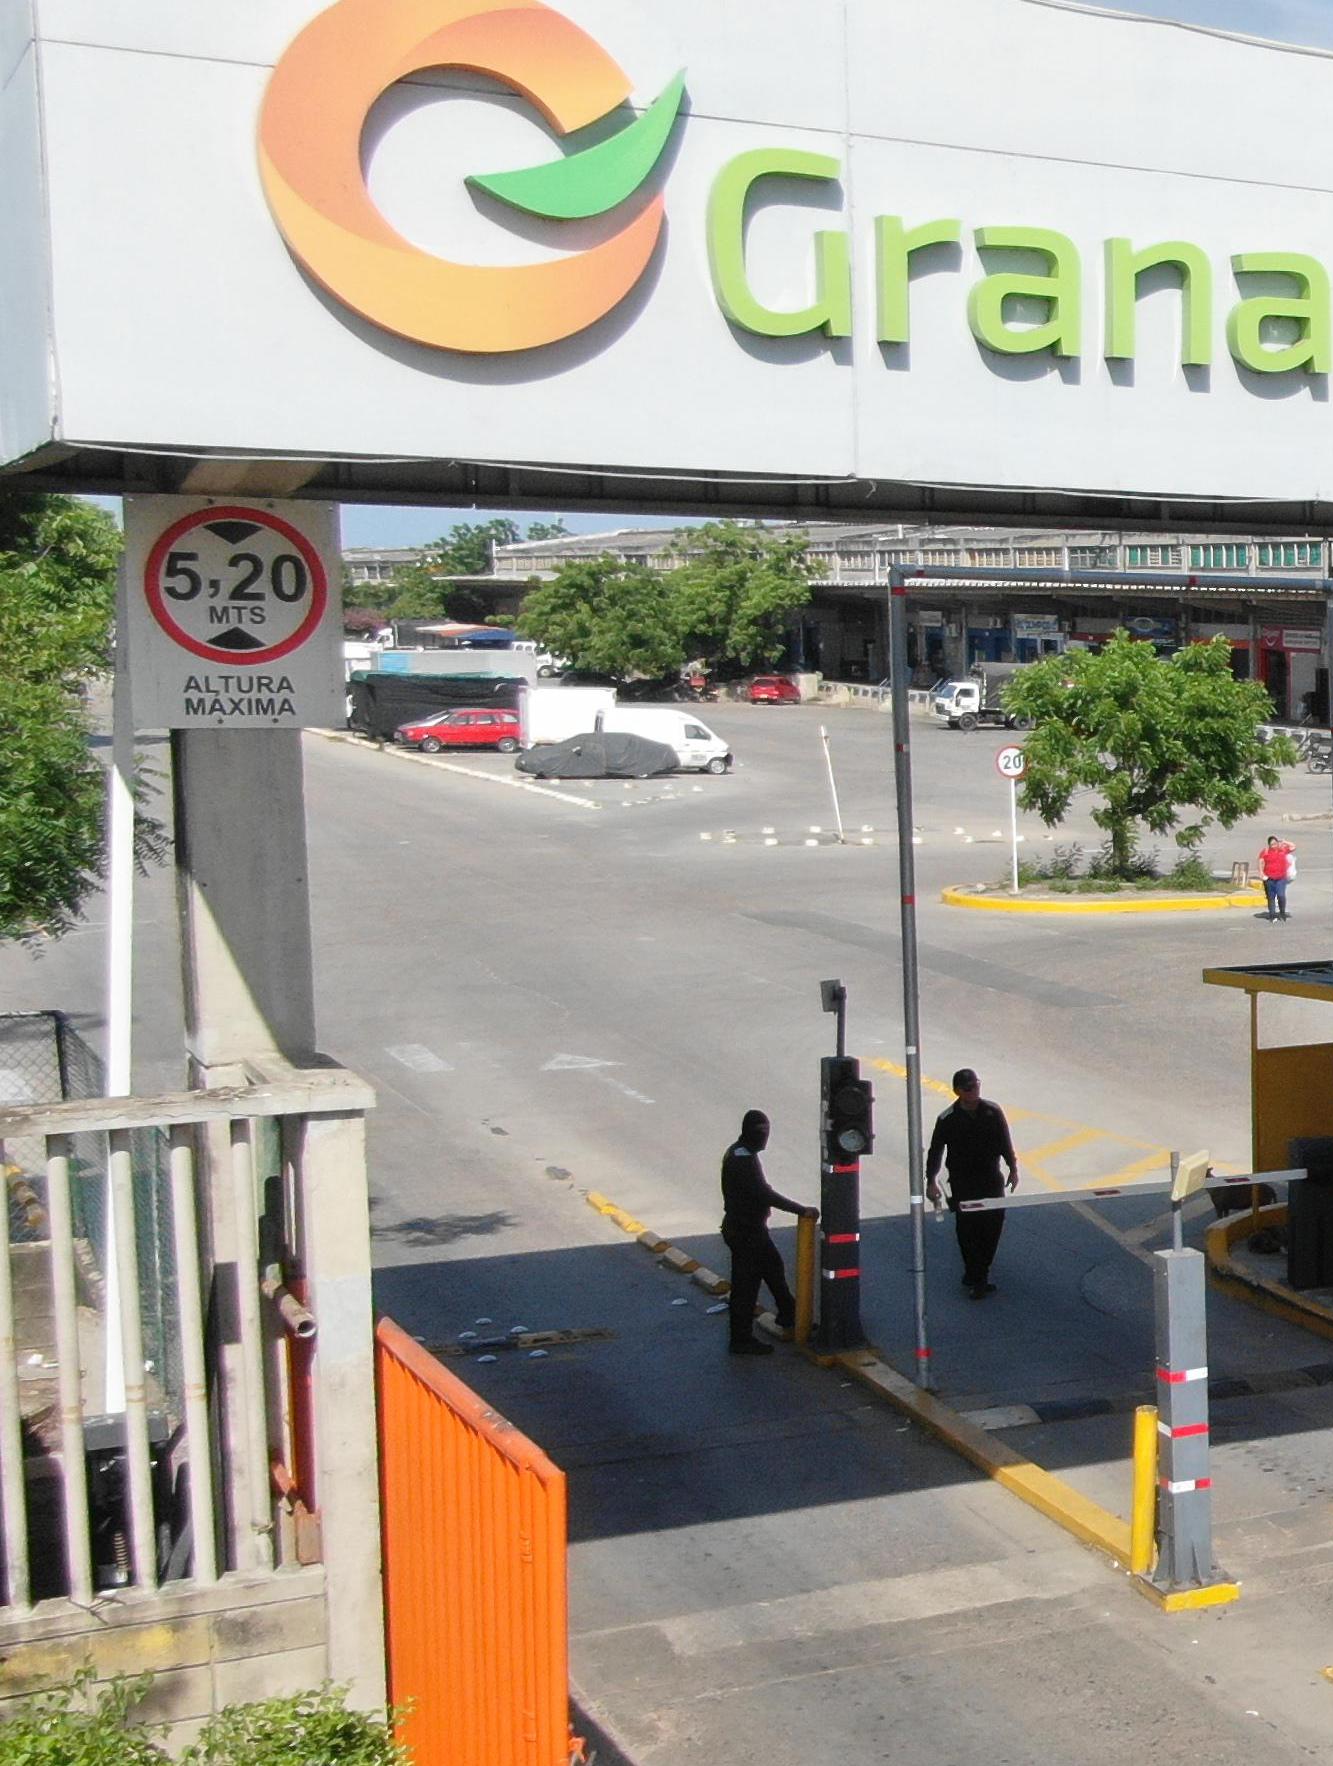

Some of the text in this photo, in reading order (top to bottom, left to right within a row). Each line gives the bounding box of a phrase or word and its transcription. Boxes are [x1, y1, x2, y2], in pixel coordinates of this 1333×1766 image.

[164, 552, 307, 602] 5,20
[209, 606, 266, 624] MTS
[183, 675, 295, 694] ALTURA
